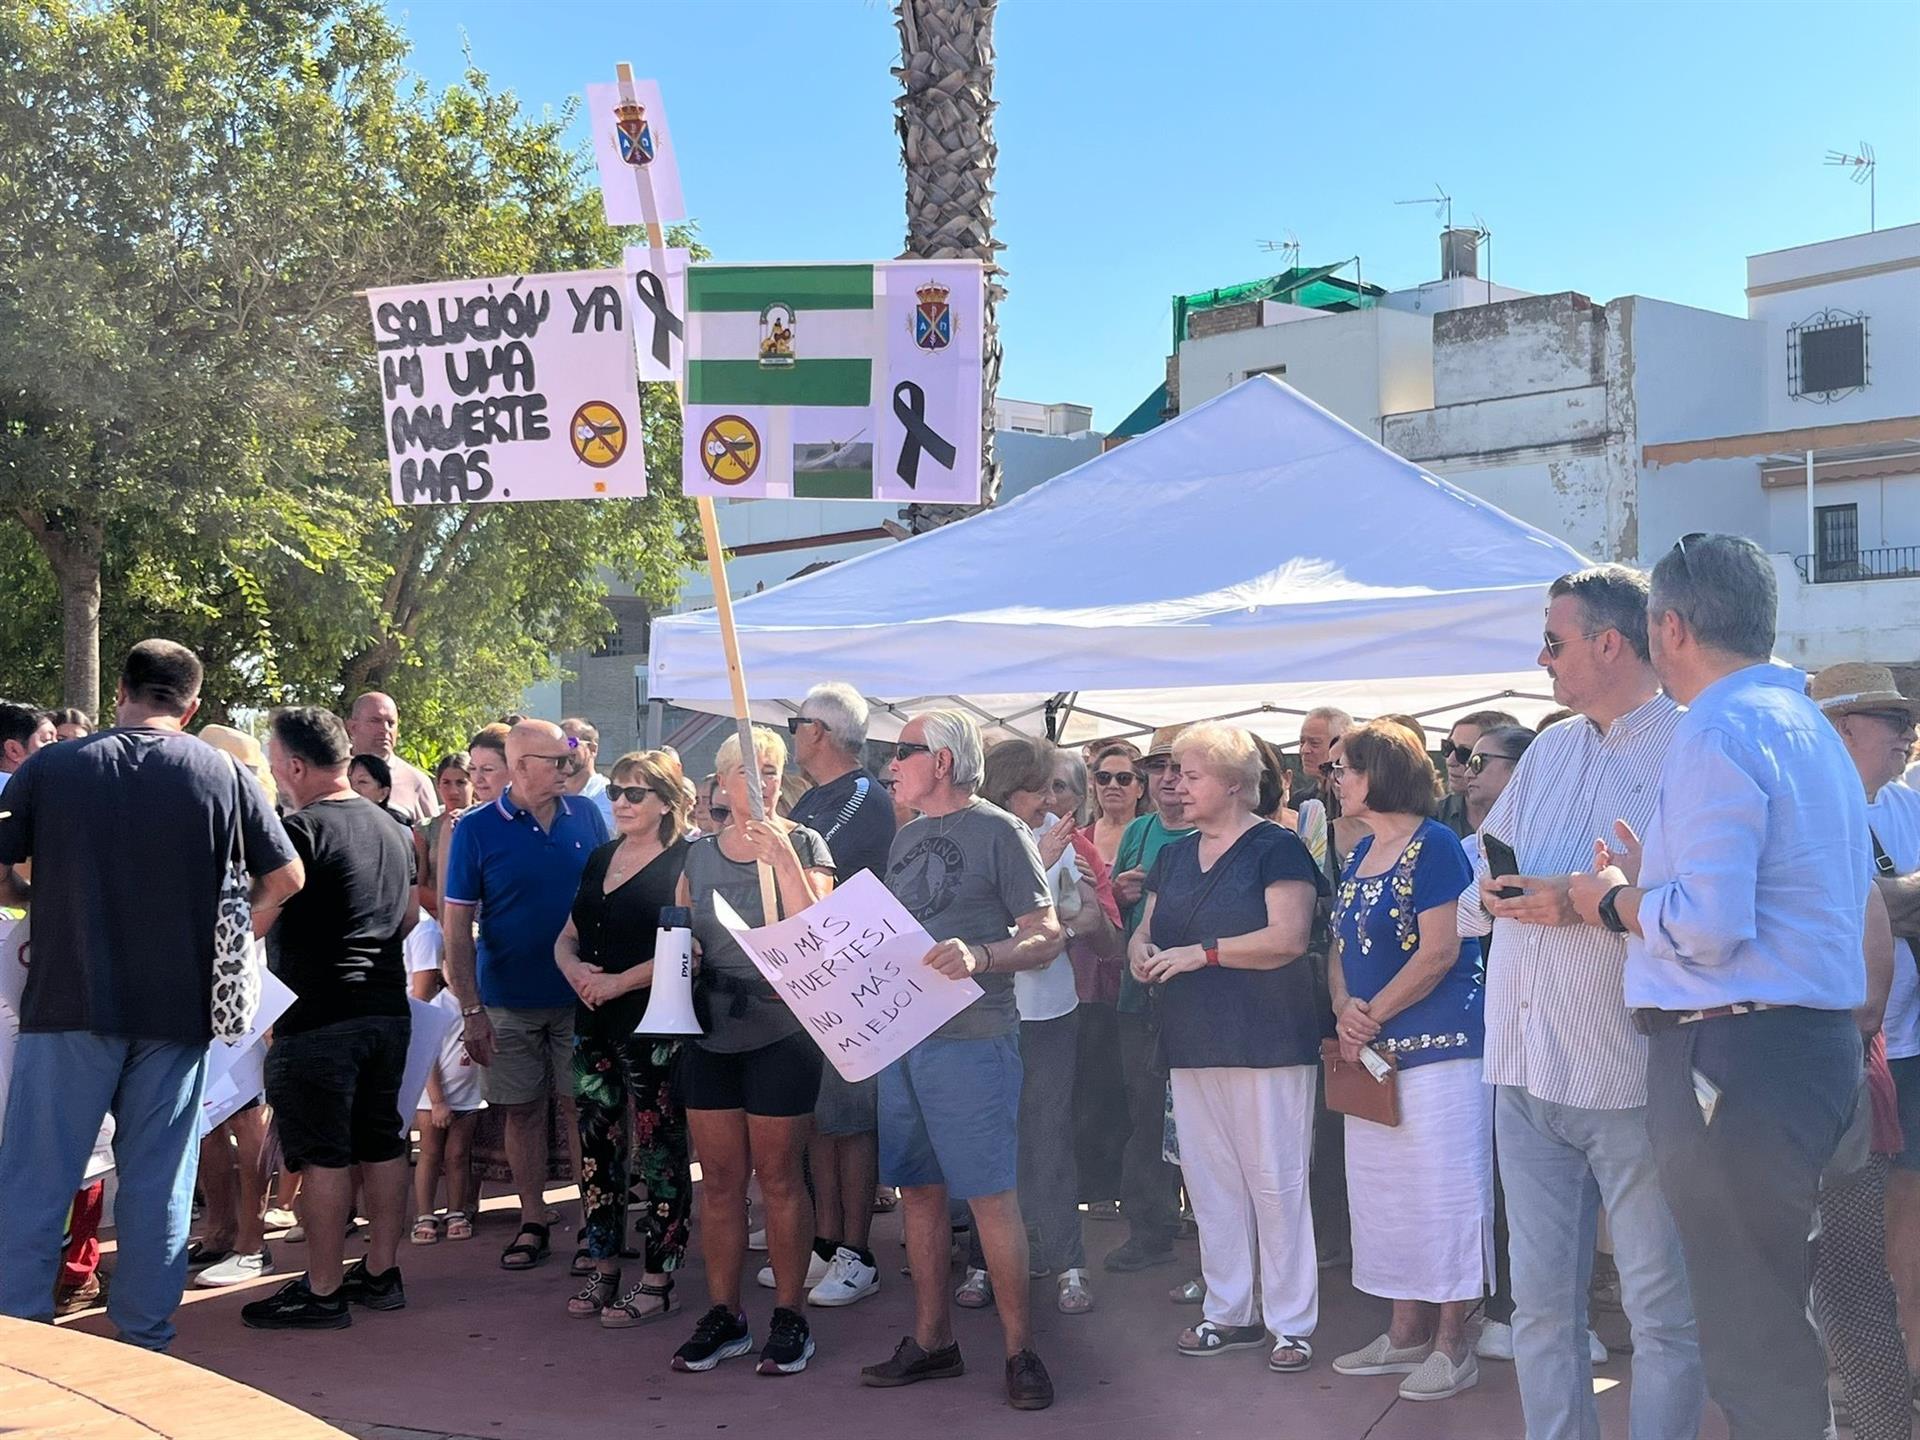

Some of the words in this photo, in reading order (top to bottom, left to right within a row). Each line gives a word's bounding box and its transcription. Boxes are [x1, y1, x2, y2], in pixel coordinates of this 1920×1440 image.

[567, 286, 622, 333] YA
[445, 341, 535, 396] UNA
[391, 393, 551, 454] MUERTE
[794, 917, 851, 957] MÁS
[681, 952, 689, 978] PYLE
[850, 961, 900, 1007] MÁS
